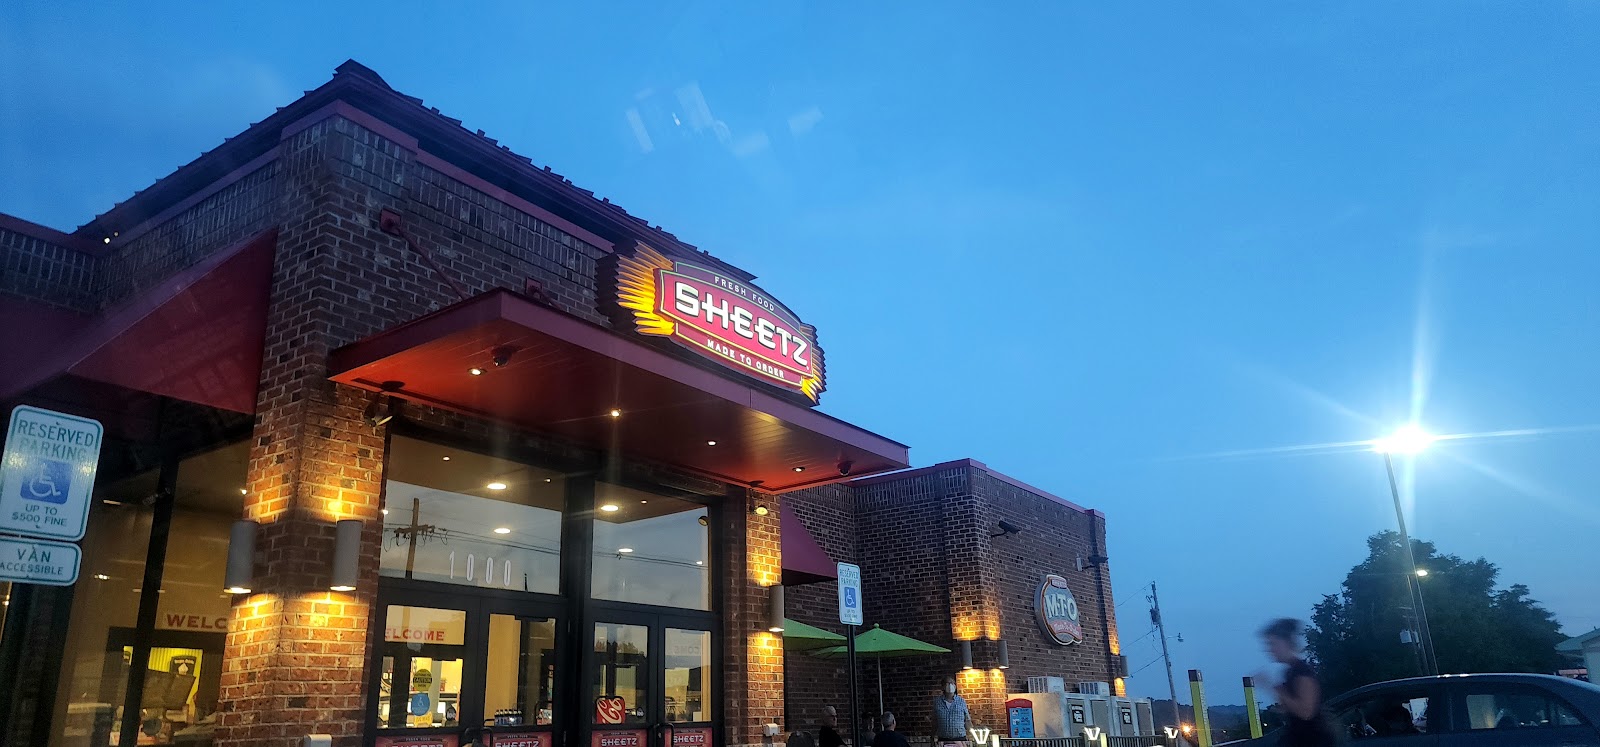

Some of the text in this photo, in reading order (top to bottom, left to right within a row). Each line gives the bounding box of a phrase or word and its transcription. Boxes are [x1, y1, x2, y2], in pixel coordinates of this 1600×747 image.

[714, 275, 775, 312] FRESH FOOD
[674, 281, 808, 367] SHEETZ
[707, 338, 785, 379] MADE TO ORDER
[18, 420, 94, 447] RESERVED
[19, 437, 88, 460] PARKING
[12, 511, 68, 527] $500 FINE
[25, 503, 58, 516] UP TO
[17, 547, 52, 563] VAN
[0, 561, 64, 576] ACCESSIBLE
[449, 550, 511, 587] 1000
[601, 737, 637, 747] SHEETZ
[672, 734, 704, 743] SHEETZ
